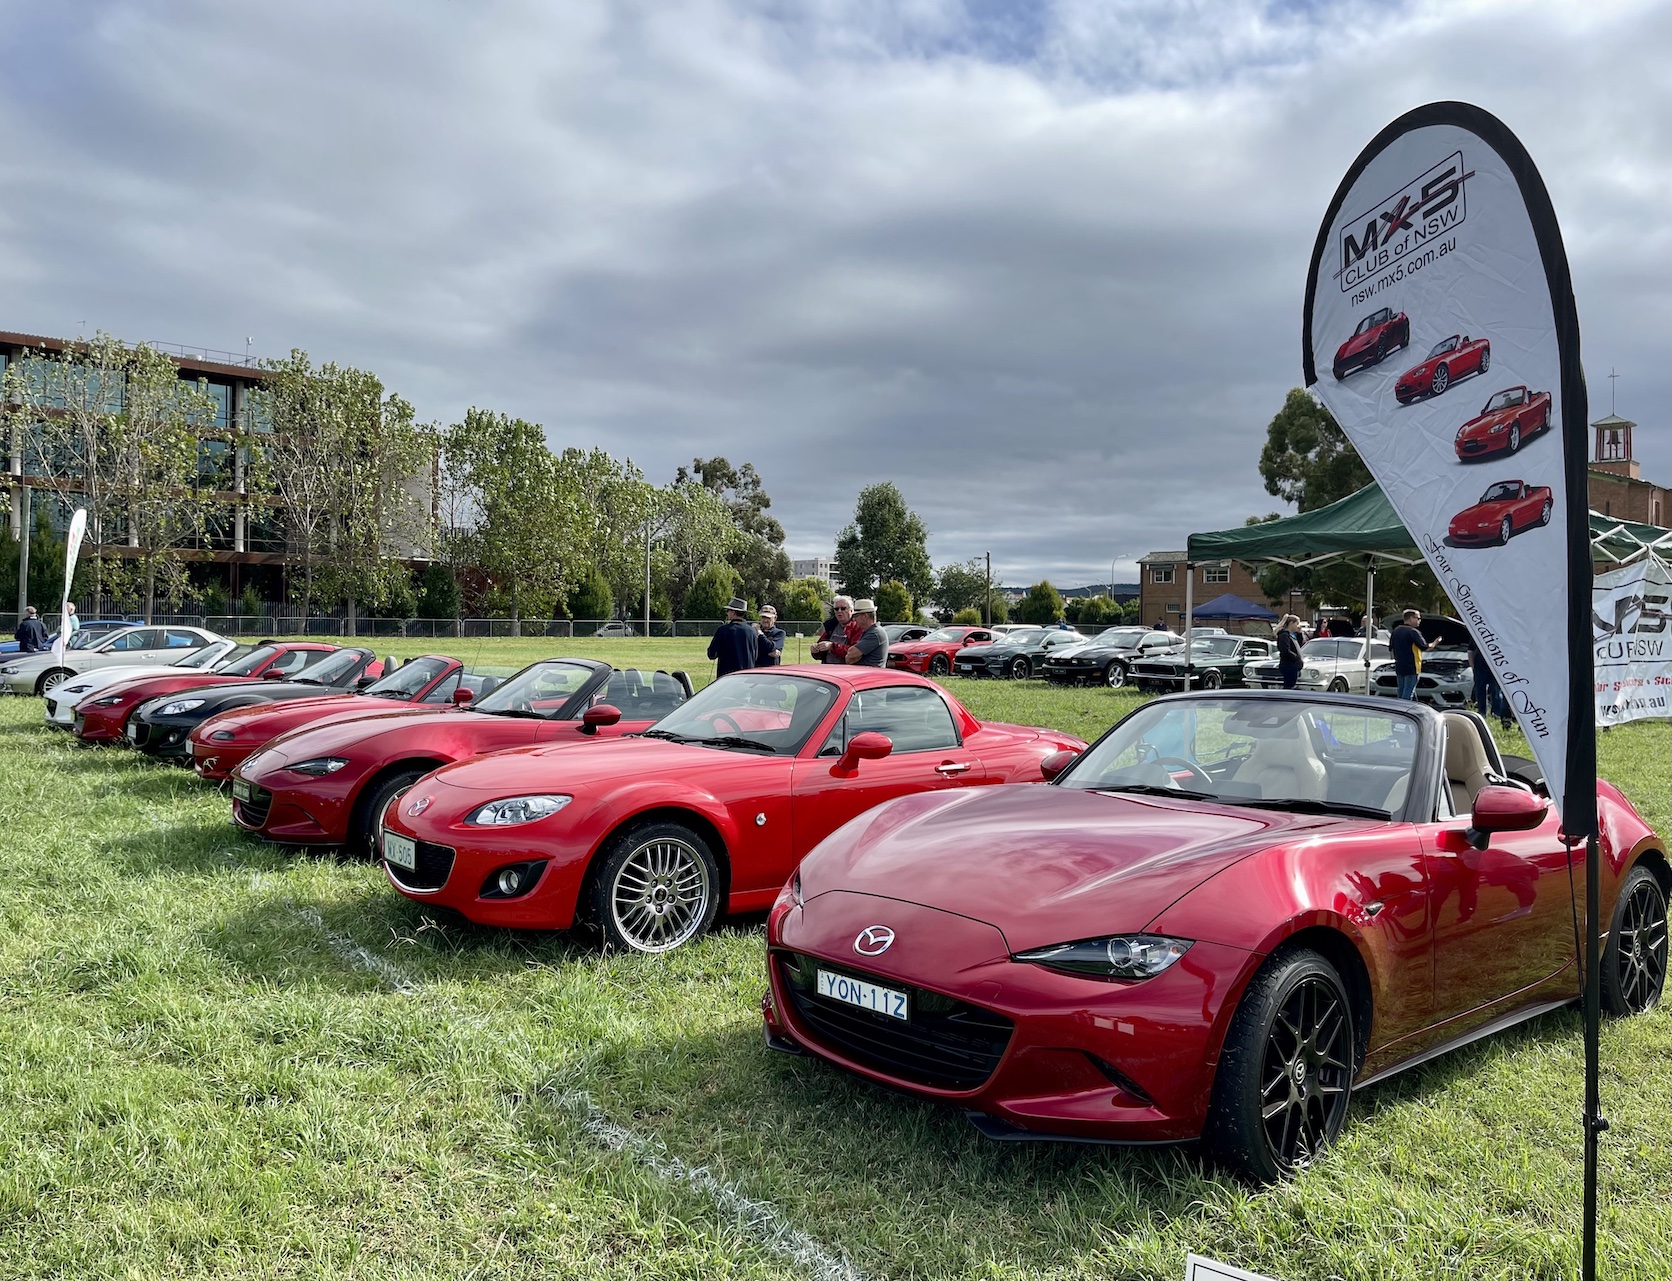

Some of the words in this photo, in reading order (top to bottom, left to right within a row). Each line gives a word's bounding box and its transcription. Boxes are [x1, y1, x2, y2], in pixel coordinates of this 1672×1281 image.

[1343, 165, 1460, 269] MX-5
[1345, 248, 1389, 285] CLUB
[1394, 234, 1410, 256] of
[1414, 204, 1459, 245] NSW
[1350, 236, 1457, 308] nsw.mx5.com.au
[1422, 532, 1454, 575] Four
[1448, 577, 1510, 668] Generations
[1502, 671, 1530, 686] of
[1511, 690, 1550, 740] Fun
